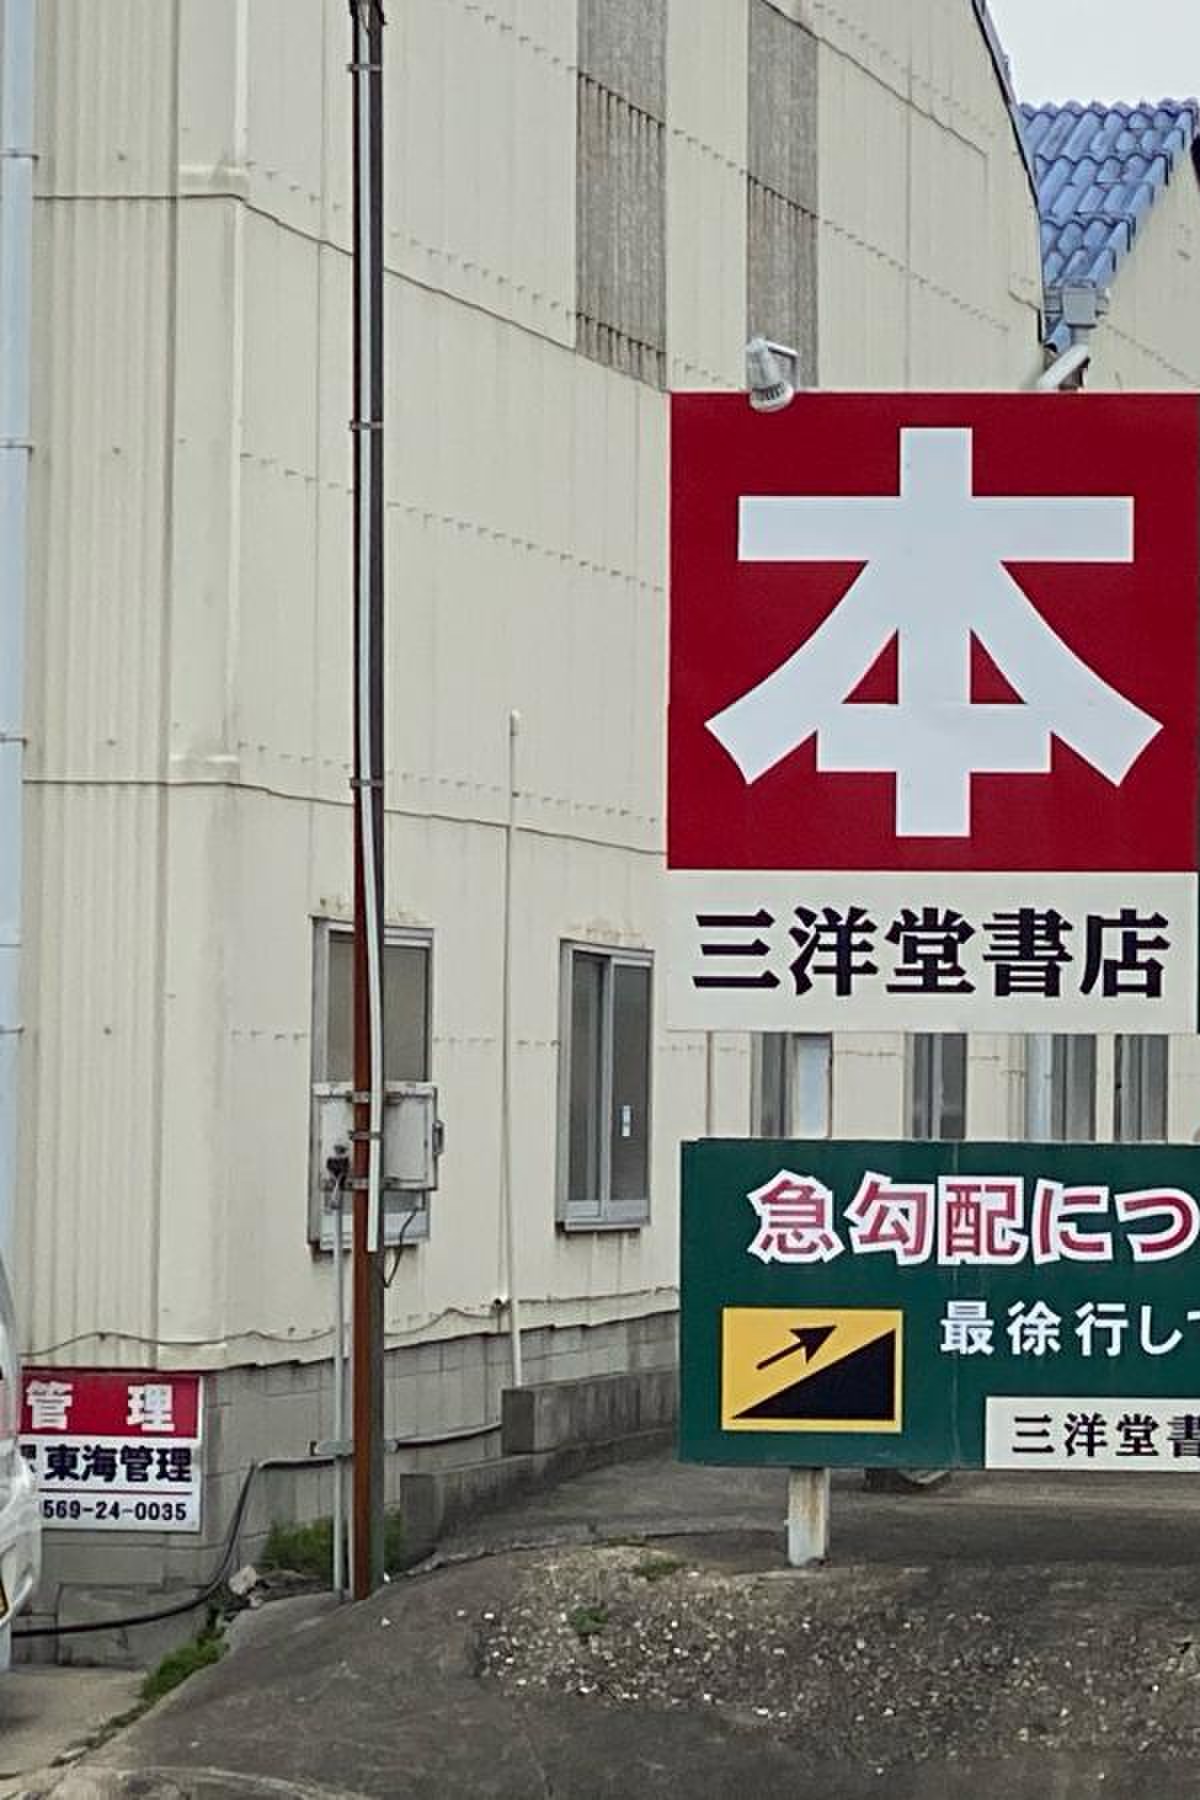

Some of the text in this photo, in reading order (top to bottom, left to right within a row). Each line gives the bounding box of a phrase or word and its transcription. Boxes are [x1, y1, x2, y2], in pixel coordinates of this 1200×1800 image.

[705, 427, 1163, 838] 本
[692, 905, 1171, 999] 三洋堂書店
[43, 1500, 187, 1521] 569-24-0035
